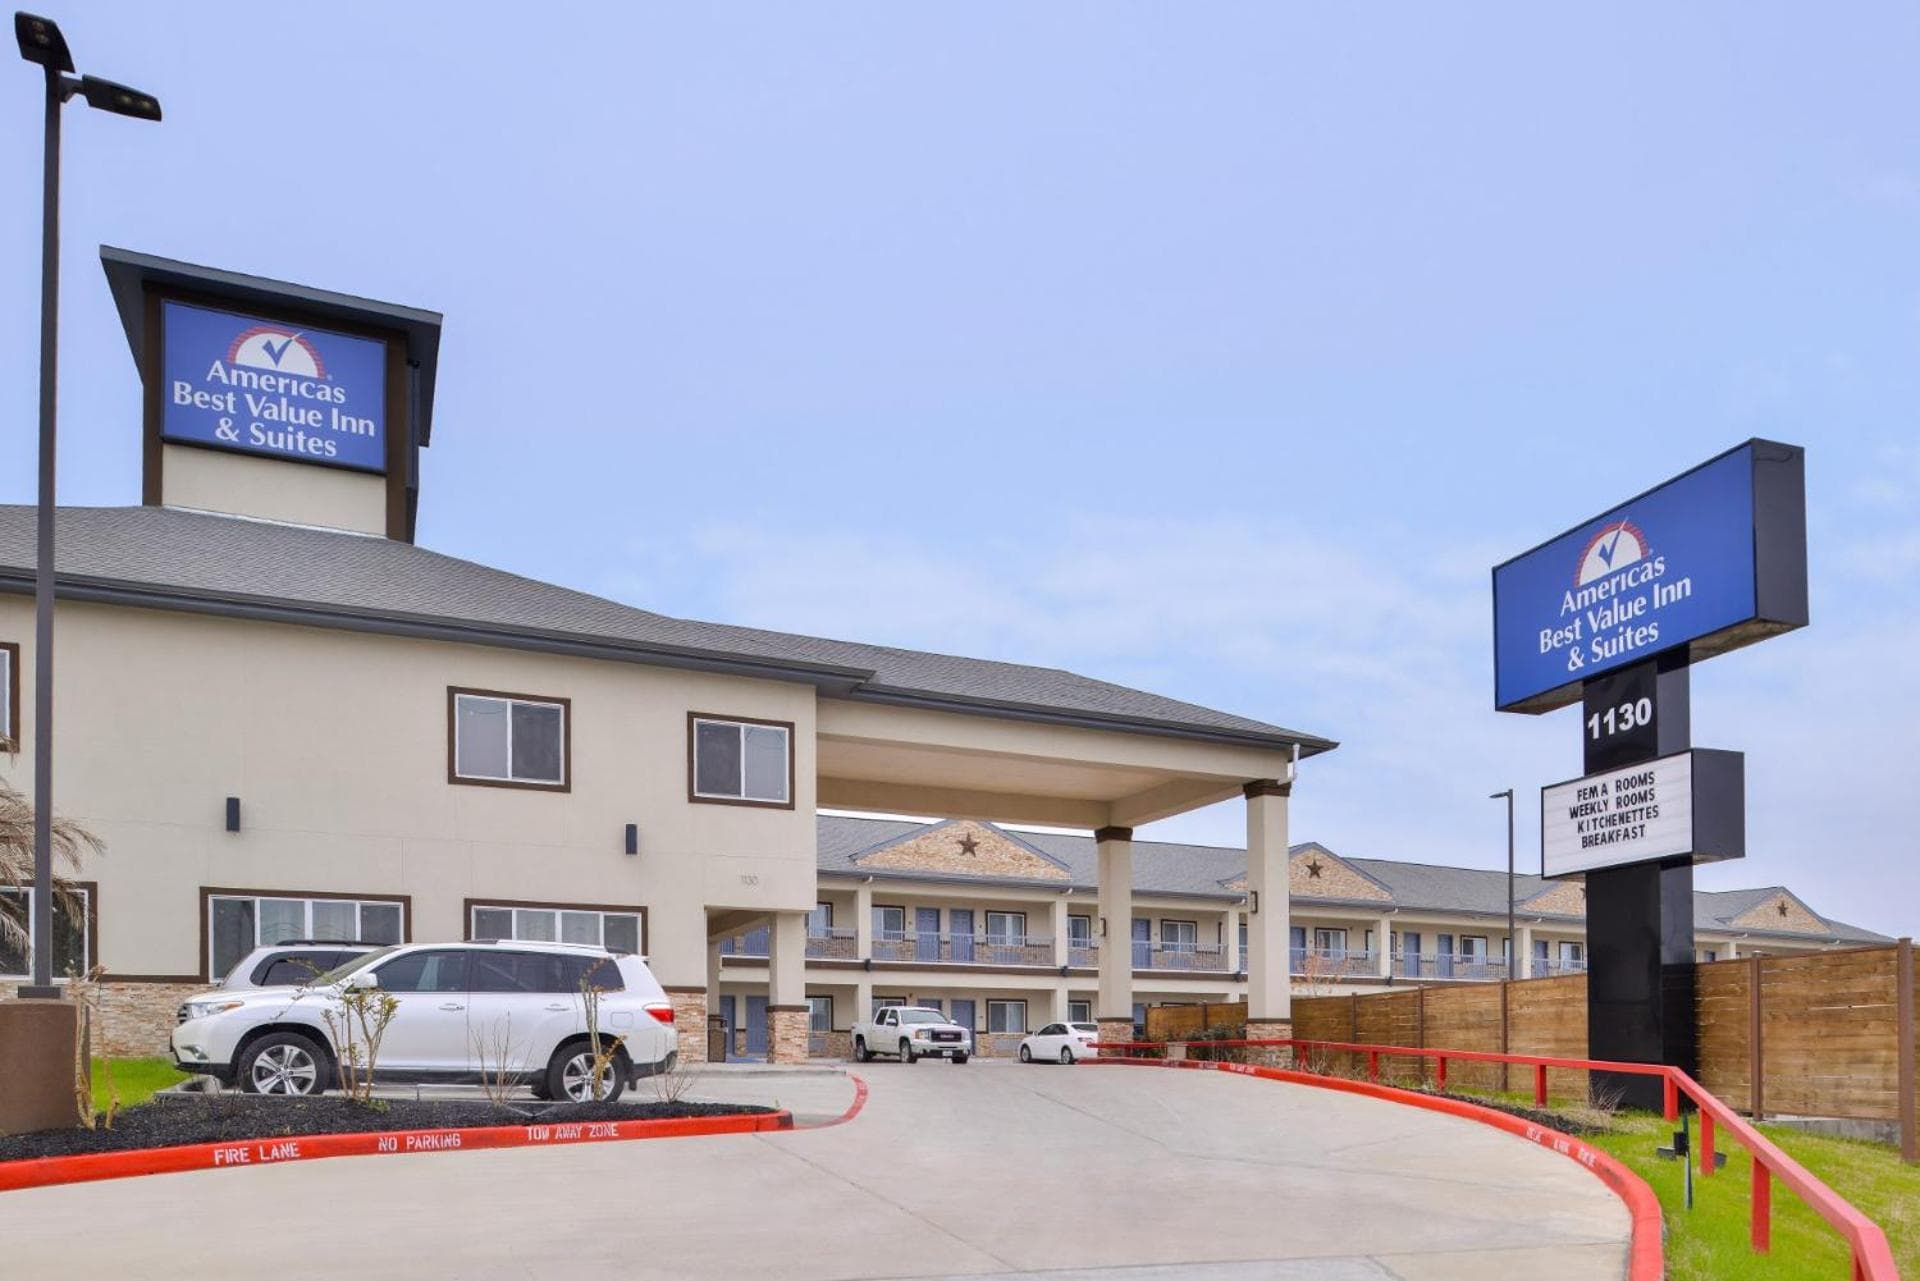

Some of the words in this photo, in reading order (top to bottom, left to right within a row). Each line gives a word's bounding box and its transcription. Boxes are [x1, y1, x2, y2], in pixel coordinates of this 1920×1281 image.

[206, 359, 346, 404] Americas
[173, 381, 236, 414] Best
[245, 393, 323, 427] Value
[331, 408, 375, 437] Inn
[215, 417, 240, 442] &
[250, 422, 337, 457] Suites
[1560, 555, 1665, 617] Americas
[1540, 617, 1582, 654] Best
[1587, 595, 1647, 633] Value
[1653, 576, 1692, 609] Inn
[1568, 646, 1585, 672] &
[1591, 621, 1660, 663] Suites
[1588, 698, 1652, 740] 1130
[1616, 771, 1655, 793] ROOMS
[1569, 800, 1609, 820] WEEKLY
[1616, 788, 1655, 809] ROOMS
[1577, 805, 1659, 834] KITCHENETTES
[1581, 824, 1646, 849] BREAKFAST
[378, 1136, 398, 1151] NO
[406, 1133, 461, 1150] PARKING
[527, 1126, 550, 1141] TOW
[555, 1125, 582, 1140] AWAY
[589, 1122, 619, 1138] ZONE
[214, 1147, 251, 1165] FIRE
[260, 1142, 301, 1161] LANE
